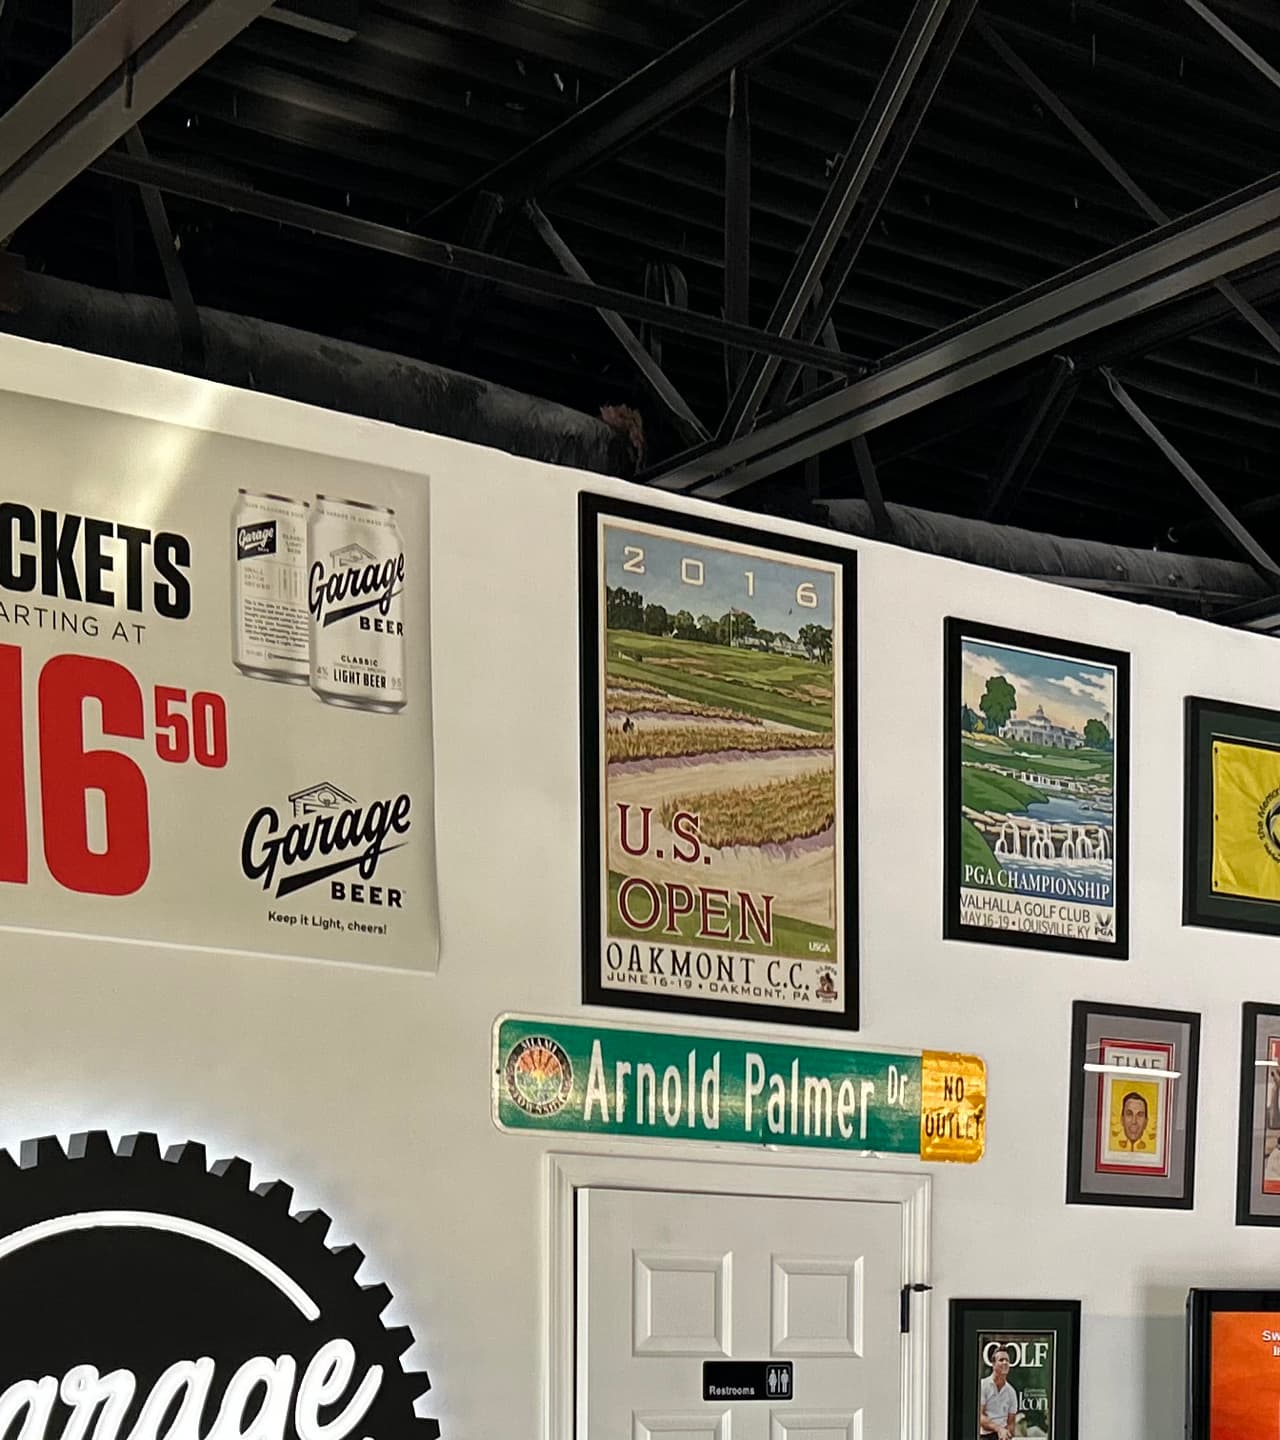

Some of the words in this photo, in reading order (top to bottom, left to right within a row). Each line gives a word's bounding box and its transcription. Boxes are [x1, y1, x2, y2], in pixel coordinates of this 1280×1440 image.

[308, 552, 406, 622] Garage
[111, 621, 147, 645] AT
[360, 616, 405, 637] BEER
[340, 655, 379, 667] CLASSIC
[333, 668, 360, 686] LIGHT
[364, 671, 387, 689] BEER
[241, 794, 411, 891] Garage
[616, 803, 712, 866] U.S.
[331, 881, 402, 908] BEER
[964, 864, 995, 886] PGA
[997, 869, 1110, 901] CHAMPIONSHIP
[619, 877, 775, 947] OPEN
[960, 892, 1023, 915] VALHALLA
[1024, 901, 1056, 919] GOLF
[1059, 906, 1090, 924] CLUB
[268, 911, 297, 925] Keep
[300, 913, 310, 926] it
[312, 916, 345, 932] Light,
[347, 920, 388, 935] cheers!
[960, 910, 982, 925] MAY
[983, 914, 1010, 930] 16-19
[1077, 925, 1091, 939] KY
[1094, 927, 1114, 937] PGA
[606, 942, 756, 984] OAKMONT
[767, 960, 811, 991] C.C.
[607, 971, 648, 985] JUNE
[652, 974, 693, 989] 16-19
[709, 982, 786, 1001] OAKMONT,
[793, 990, 811, 1002] PA
[583, 1038, 721, 1131] Arnold
[744, 1051, 875, 1141] Palmer
[887, 1064, 909, 1106] Dr
[943, 1074, 965, 1102] NO
[924, 1112, 985, 1142] OUTLET
[709, 1385, 756, 1396] Restrooms
